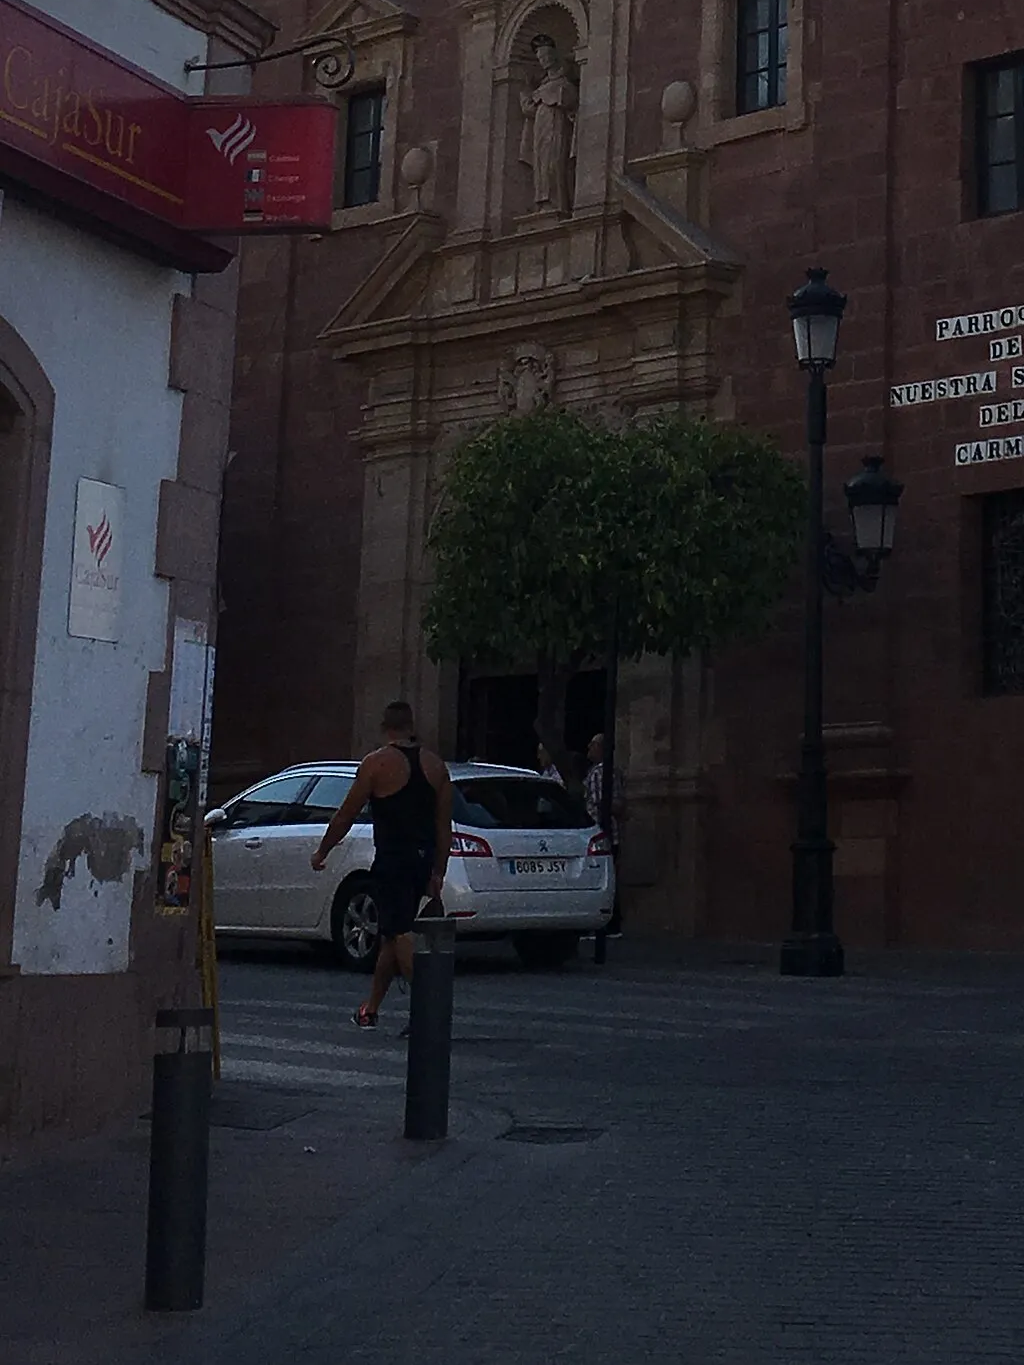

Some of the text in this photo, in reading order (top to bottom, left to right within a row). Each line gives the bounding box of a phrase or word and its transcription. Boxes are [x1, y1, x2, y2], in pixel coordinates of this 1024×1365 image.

[4, 45, 142, 164] CajaSur
[991, 336, 1020, 359] DE
[891, 374, 994, 406] NUESTRA
[516, 860, 544, 873] 6085
